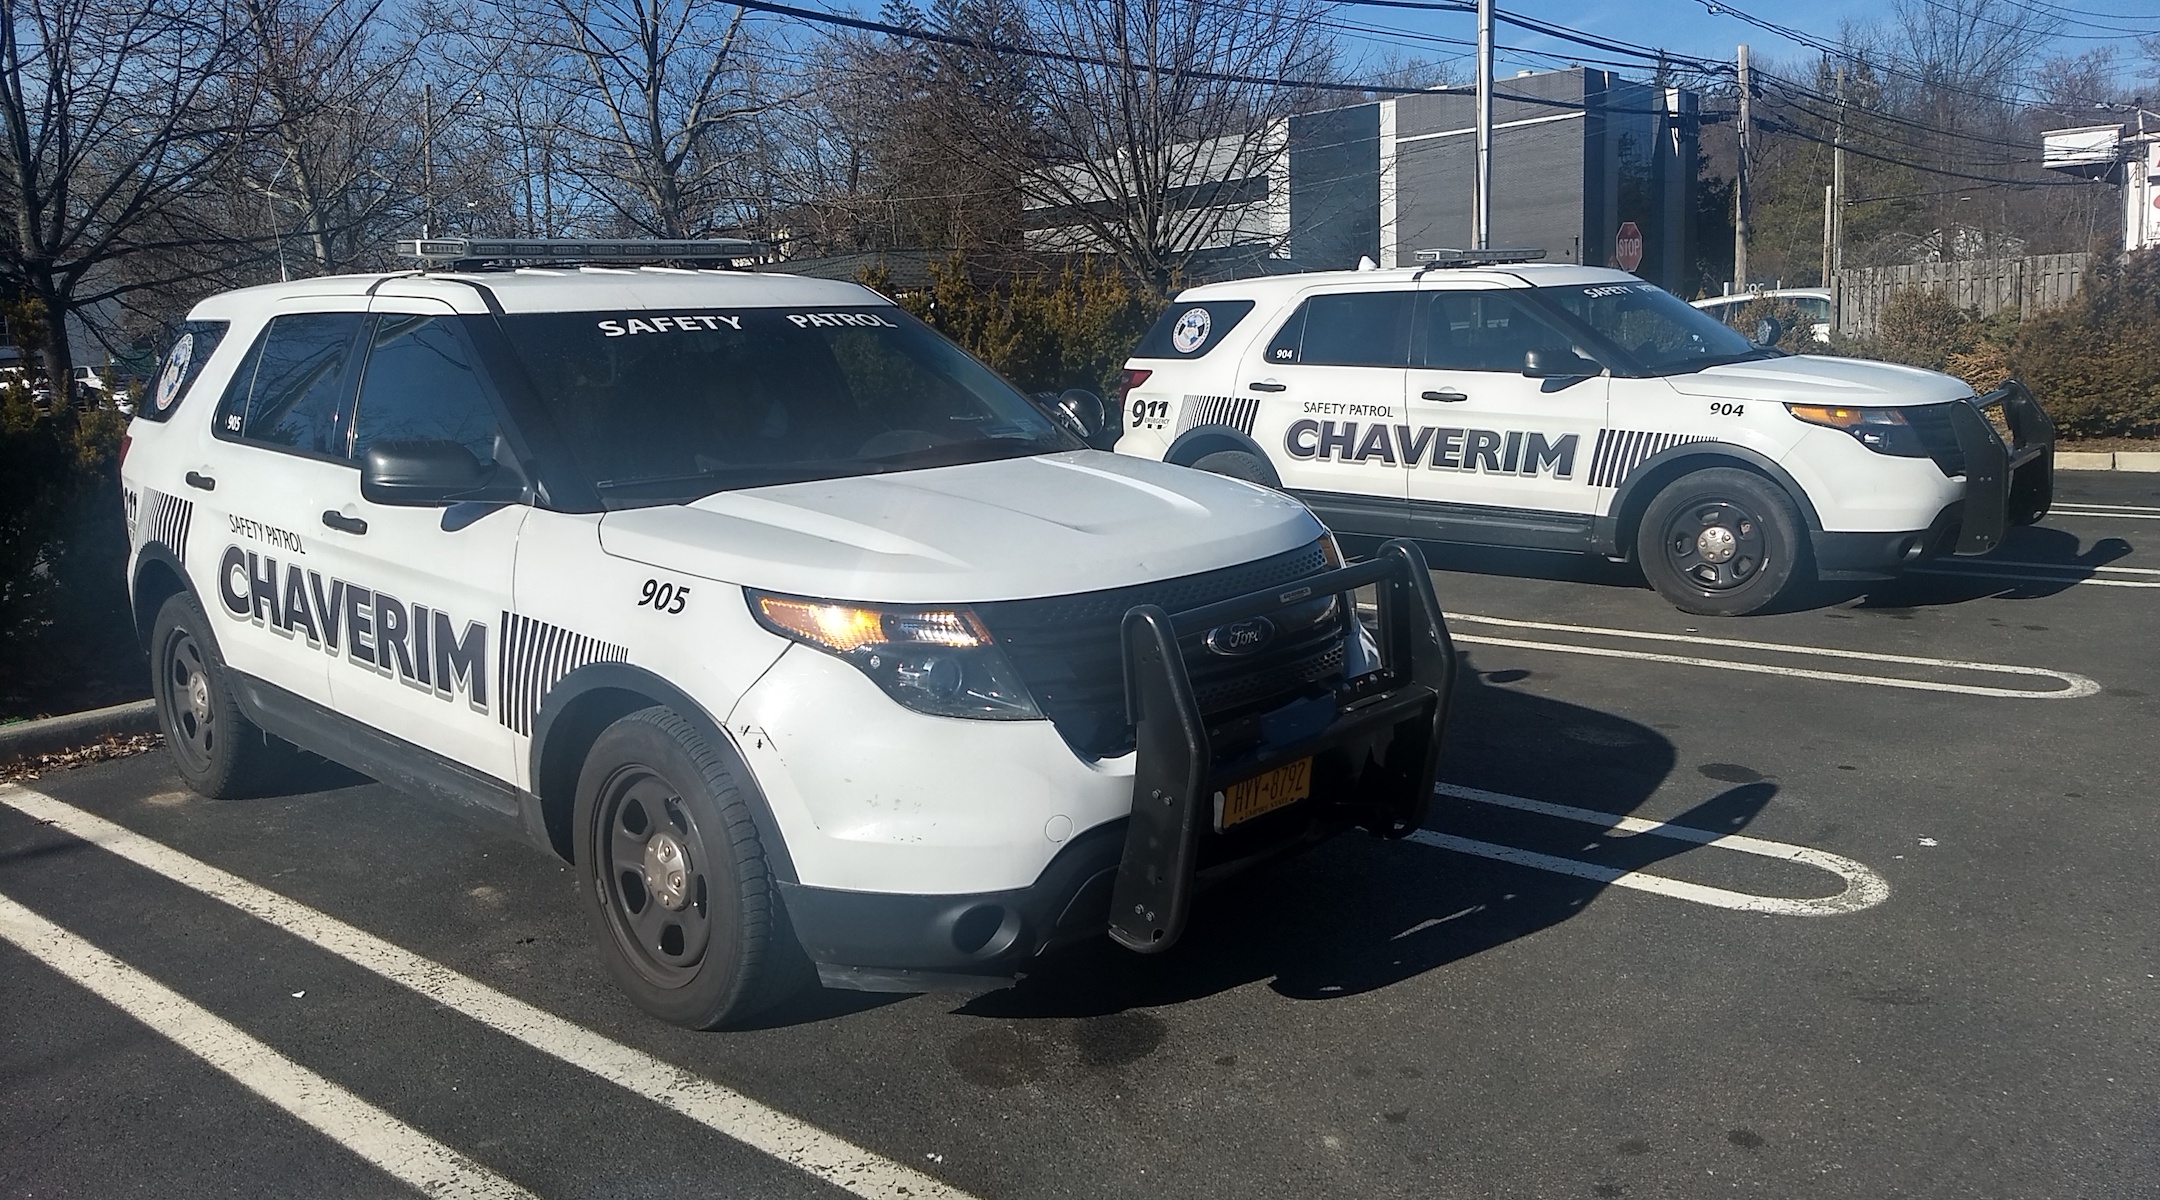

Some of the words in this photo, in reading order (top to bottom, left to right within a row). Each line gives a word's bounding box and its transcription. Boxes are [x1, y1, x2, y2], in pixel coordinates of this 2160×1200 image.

[1618, 238, 1640, 257] STOP
[1583, 286, 1634, 298] SAFETY
[597, 315, 742, 338] SAFETY
[786, 313, 899, 329] PATROL
[1276, 349, 1294, 360] 904
[1132, 400, 1169, 428] 911
[1303, 402, 1346, 415] SAFETY
[1349, 404, 1394, 418] PATROL
[1710, 402, 1745, 417] 904
[226, 414, 242, 432] 905
[1284, 419, 1581, 480] CHAVERIM
[229, 513, 263, 542] SAFETY
[265, 525, 306, 555] PATROL
[637, 578, 691, 614] 905
[217, 543, 490, 716] CHAVERIM
[1229, 621, 1263, 648] Ford
[1270, 762, 1306, 800] 8792
